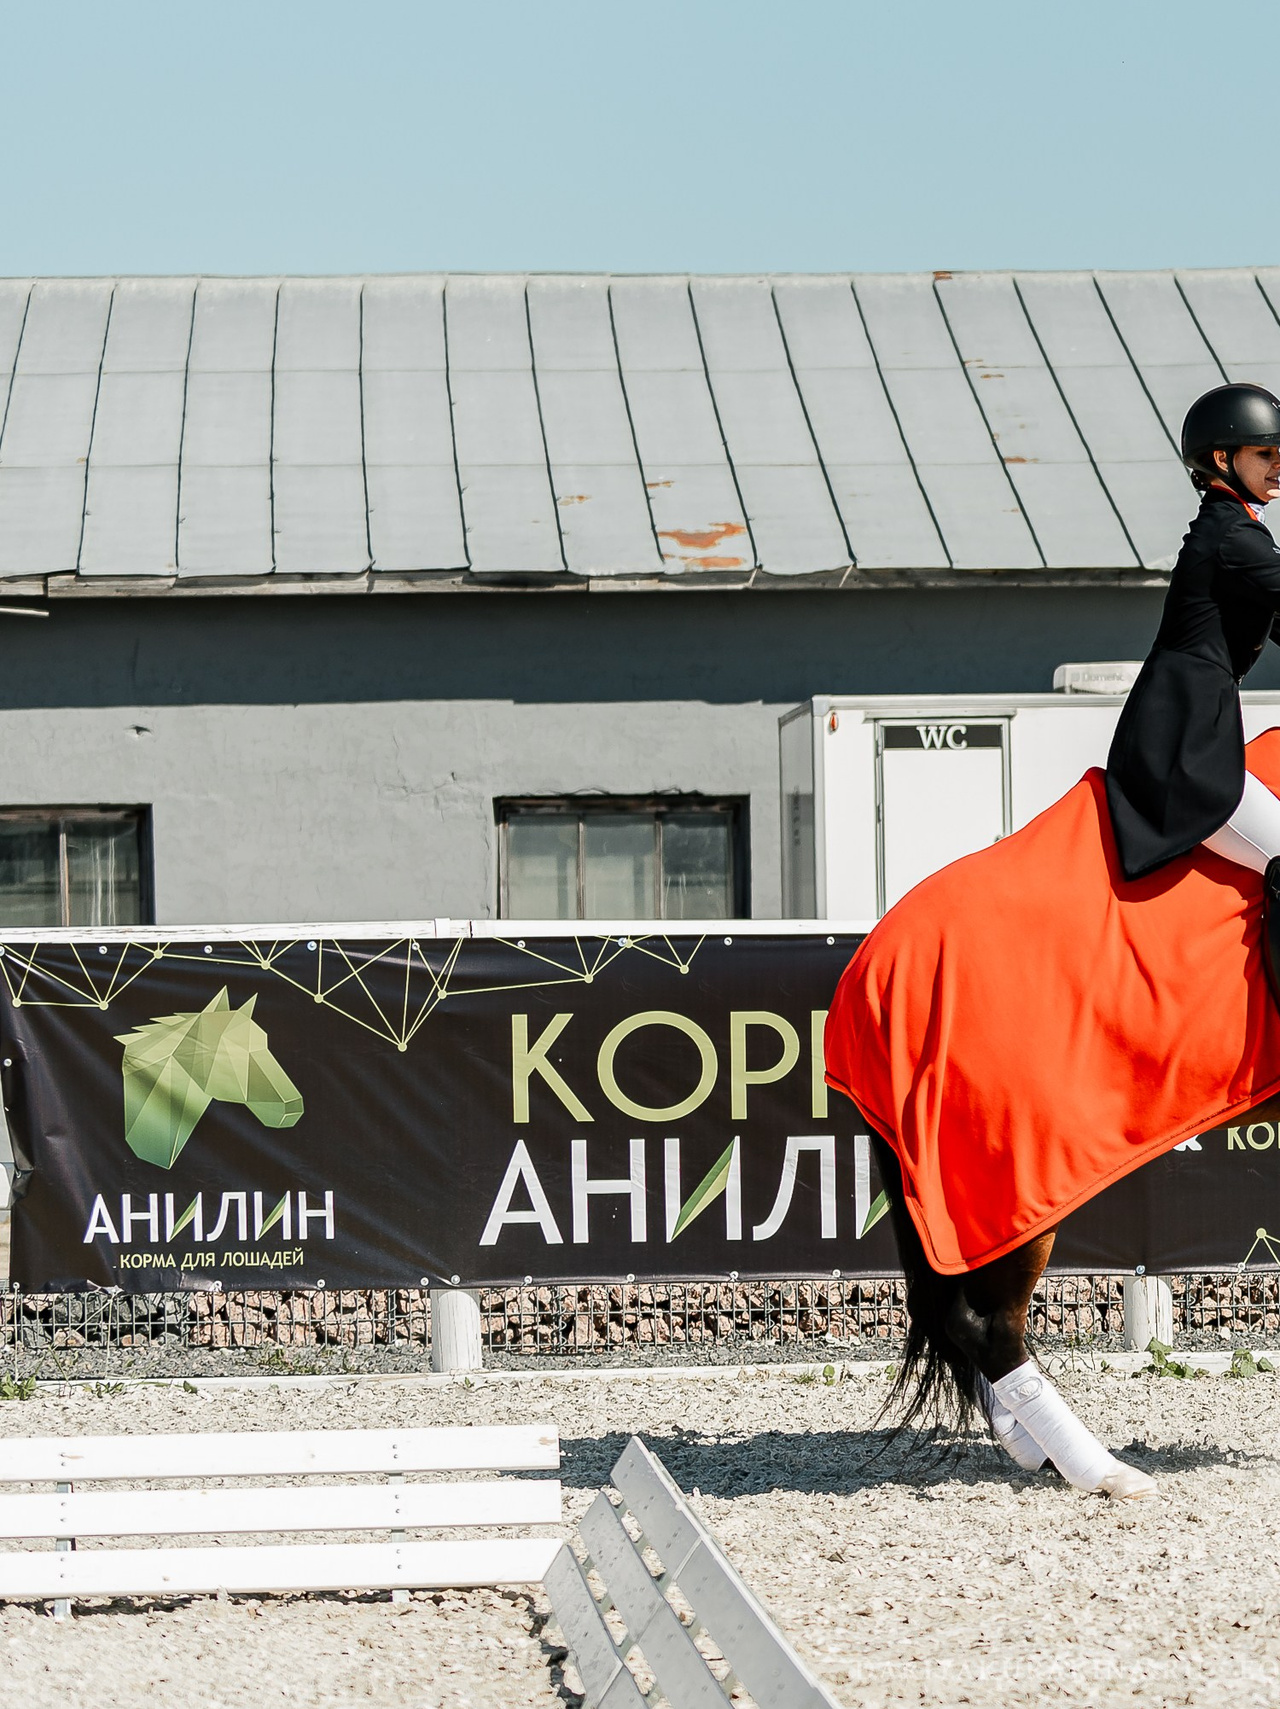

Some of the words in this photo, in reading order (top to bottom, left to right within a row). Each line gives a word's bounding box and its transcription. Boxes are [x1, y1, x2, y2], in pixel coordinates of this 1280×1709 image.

[916, 725, 967, 750] WC
[511, 1010, 829, 1124] КОР
[83, 1190, 335, 1244] АНИЛИН
[119, 1253, 177, 1269] КОРМА
[180, 1252, 216, 1271] ДЛЯ
[220, 1247, 305, 1270] ЛОШАДЕЙ
